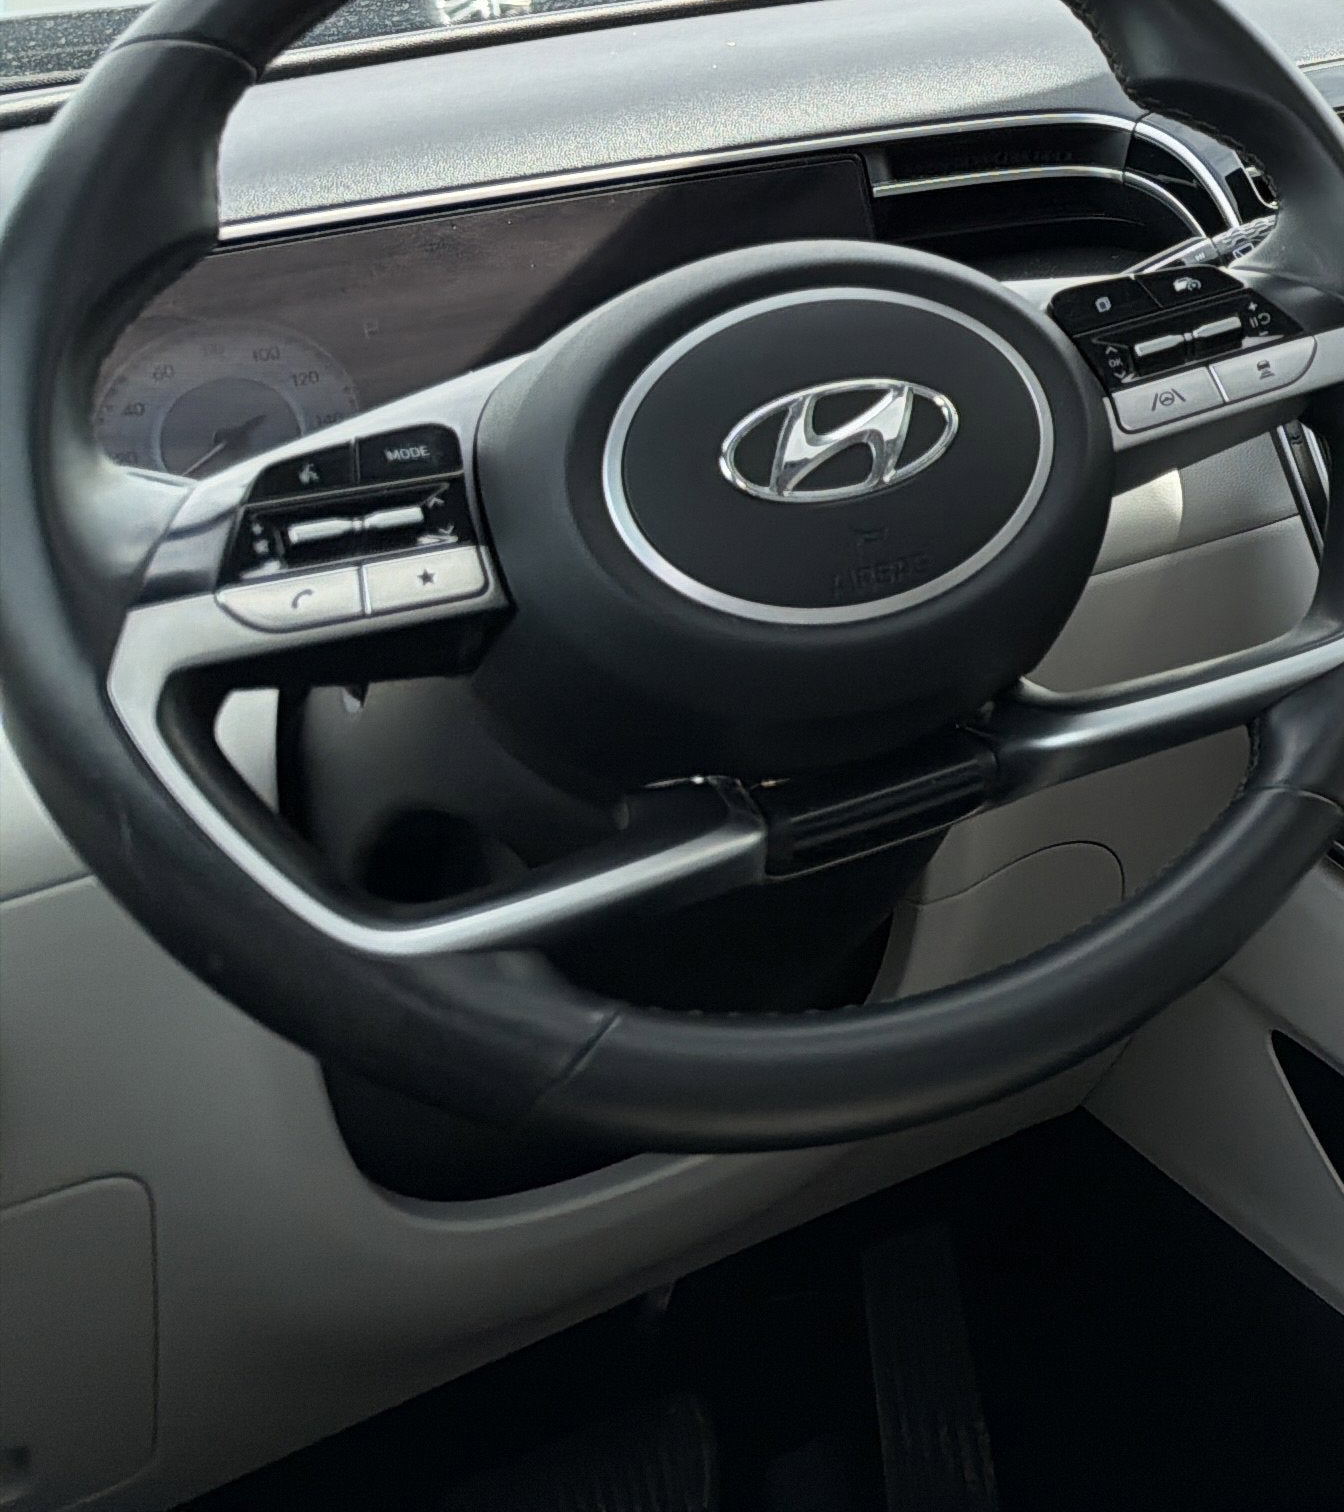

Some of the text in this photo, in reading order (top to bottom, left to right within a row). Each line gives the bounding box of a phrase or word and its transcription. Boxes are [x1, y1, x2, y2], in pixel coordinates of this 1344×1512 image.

[1108, 357, 1123, 369] OK
[292, 369, 319, 388] 120
[385, 443, 431, 462] MODE
